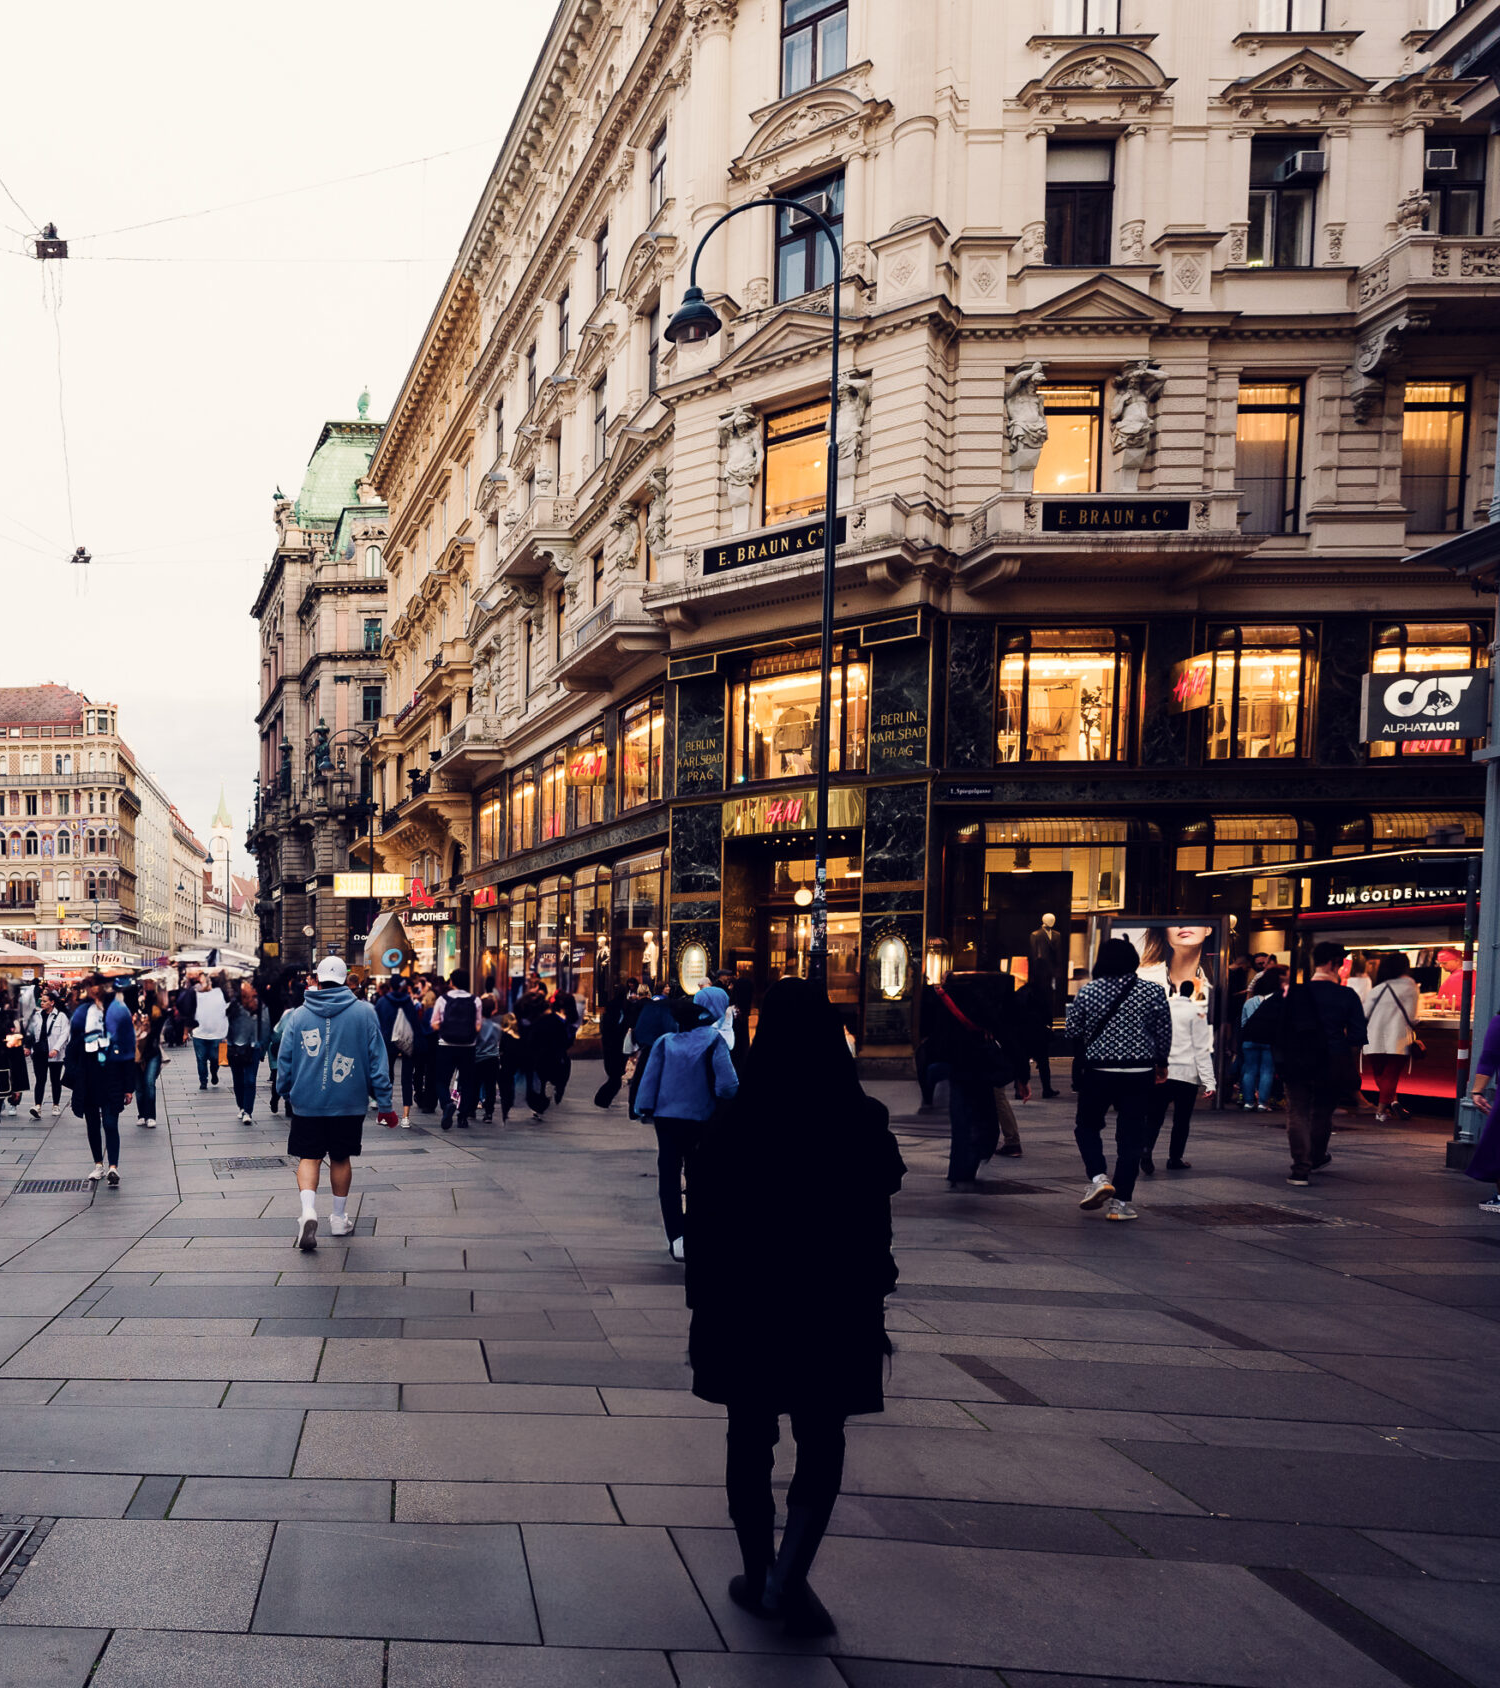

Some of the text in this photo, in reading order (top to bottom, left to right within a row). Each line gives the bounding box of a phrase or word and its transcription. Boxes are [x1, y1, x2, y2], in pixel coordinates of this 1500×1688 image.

[1058, 509, 1072, 524] E.
[1079, 509, 1135, 525] BRAUN
[1141, 514, 1147, 524] &
[718, 551, 731, 567] E.
[737, 536, 790, 563] BRAUN
[795, 538, 803, 549] &
[880, 710, 918, 726] BERLIN
[1382, 721, 1460, 733] ALPHATAURI
[870, 726, 927, 744] KARLSBAD
[685, 738, 717, 753] BERLIN
[881, 744, 914, 759] PRAG
[677, 752, 724, 769] KARLSBAD
[687, 768, 715, 783] PRAG
[765, 799, 803, 825] H&M
[1327, 893, 1356, 906] ZUM
[412, 911, 450, 921] APOTHEKE
